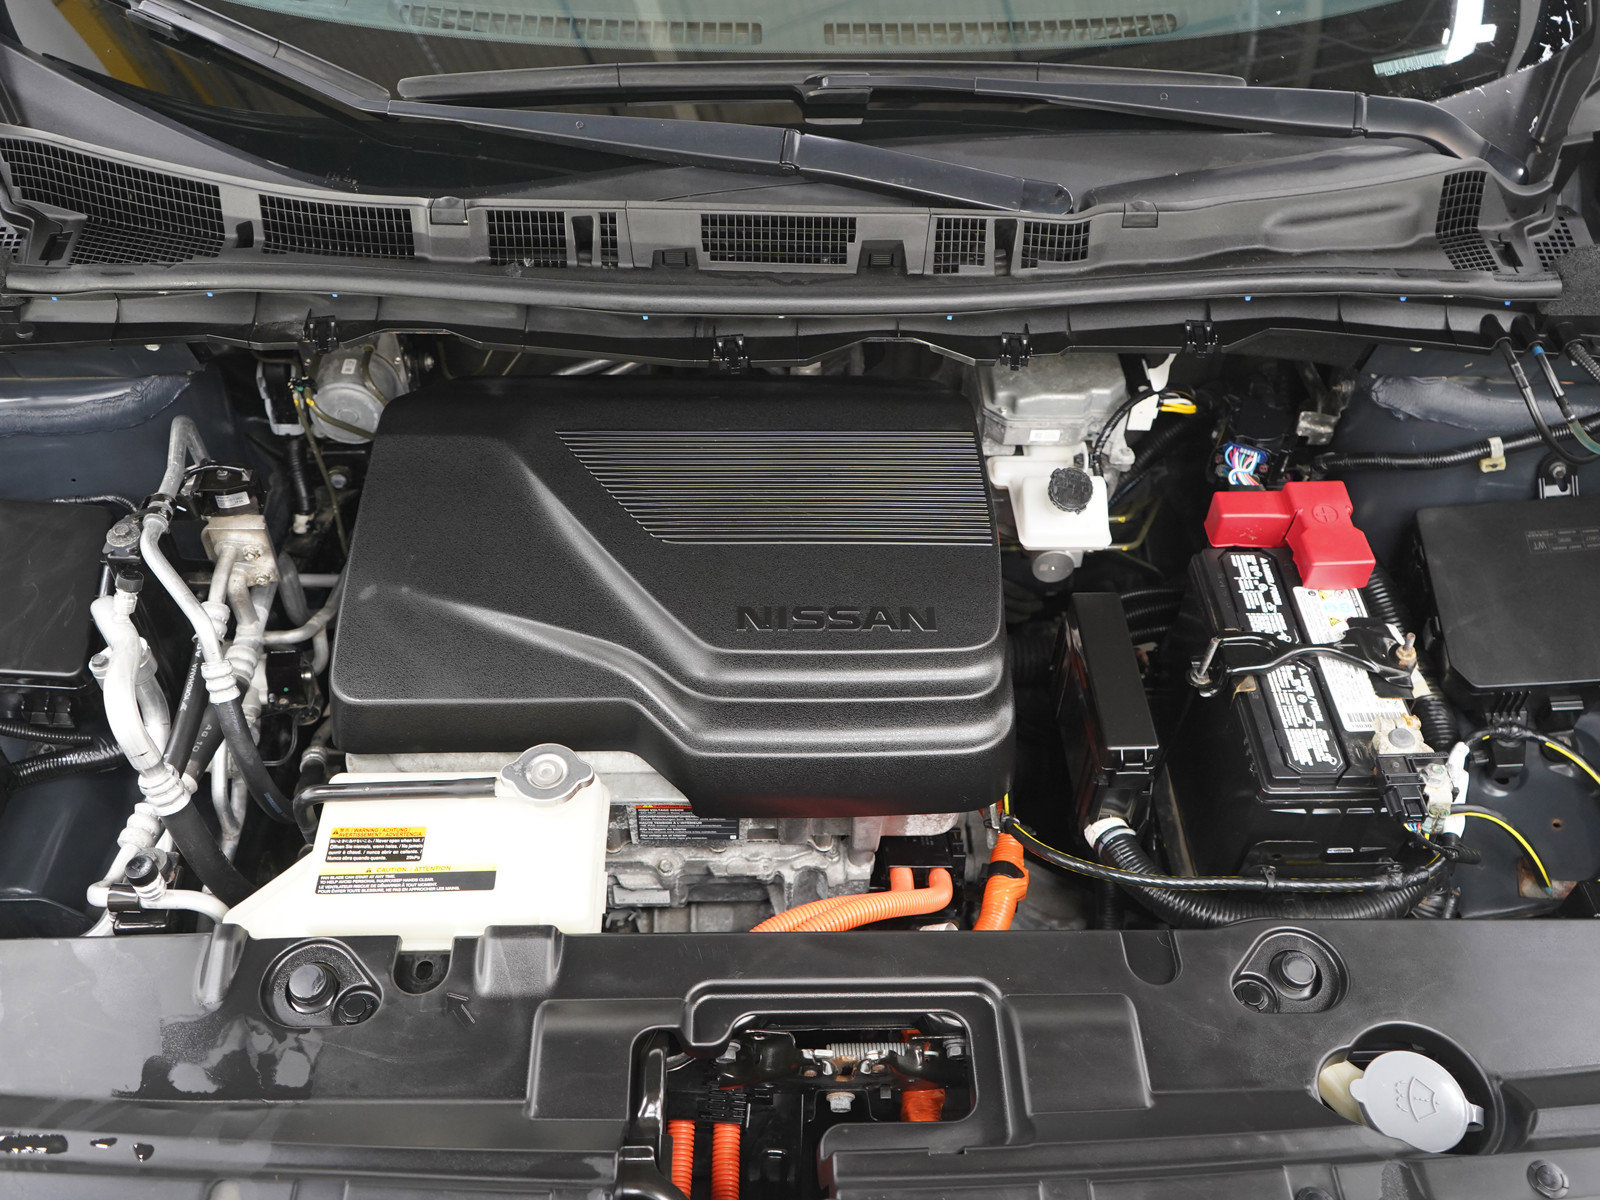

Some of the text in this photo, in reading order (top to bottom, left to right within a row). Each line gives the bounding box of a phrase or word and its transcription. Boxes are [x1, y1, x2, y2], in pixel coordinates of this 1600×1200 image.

[736, 606, 938, 632] NISSAN
[183, 663, 198, 700] YOKOHAMA
[201, 724, 212, 738] AG
